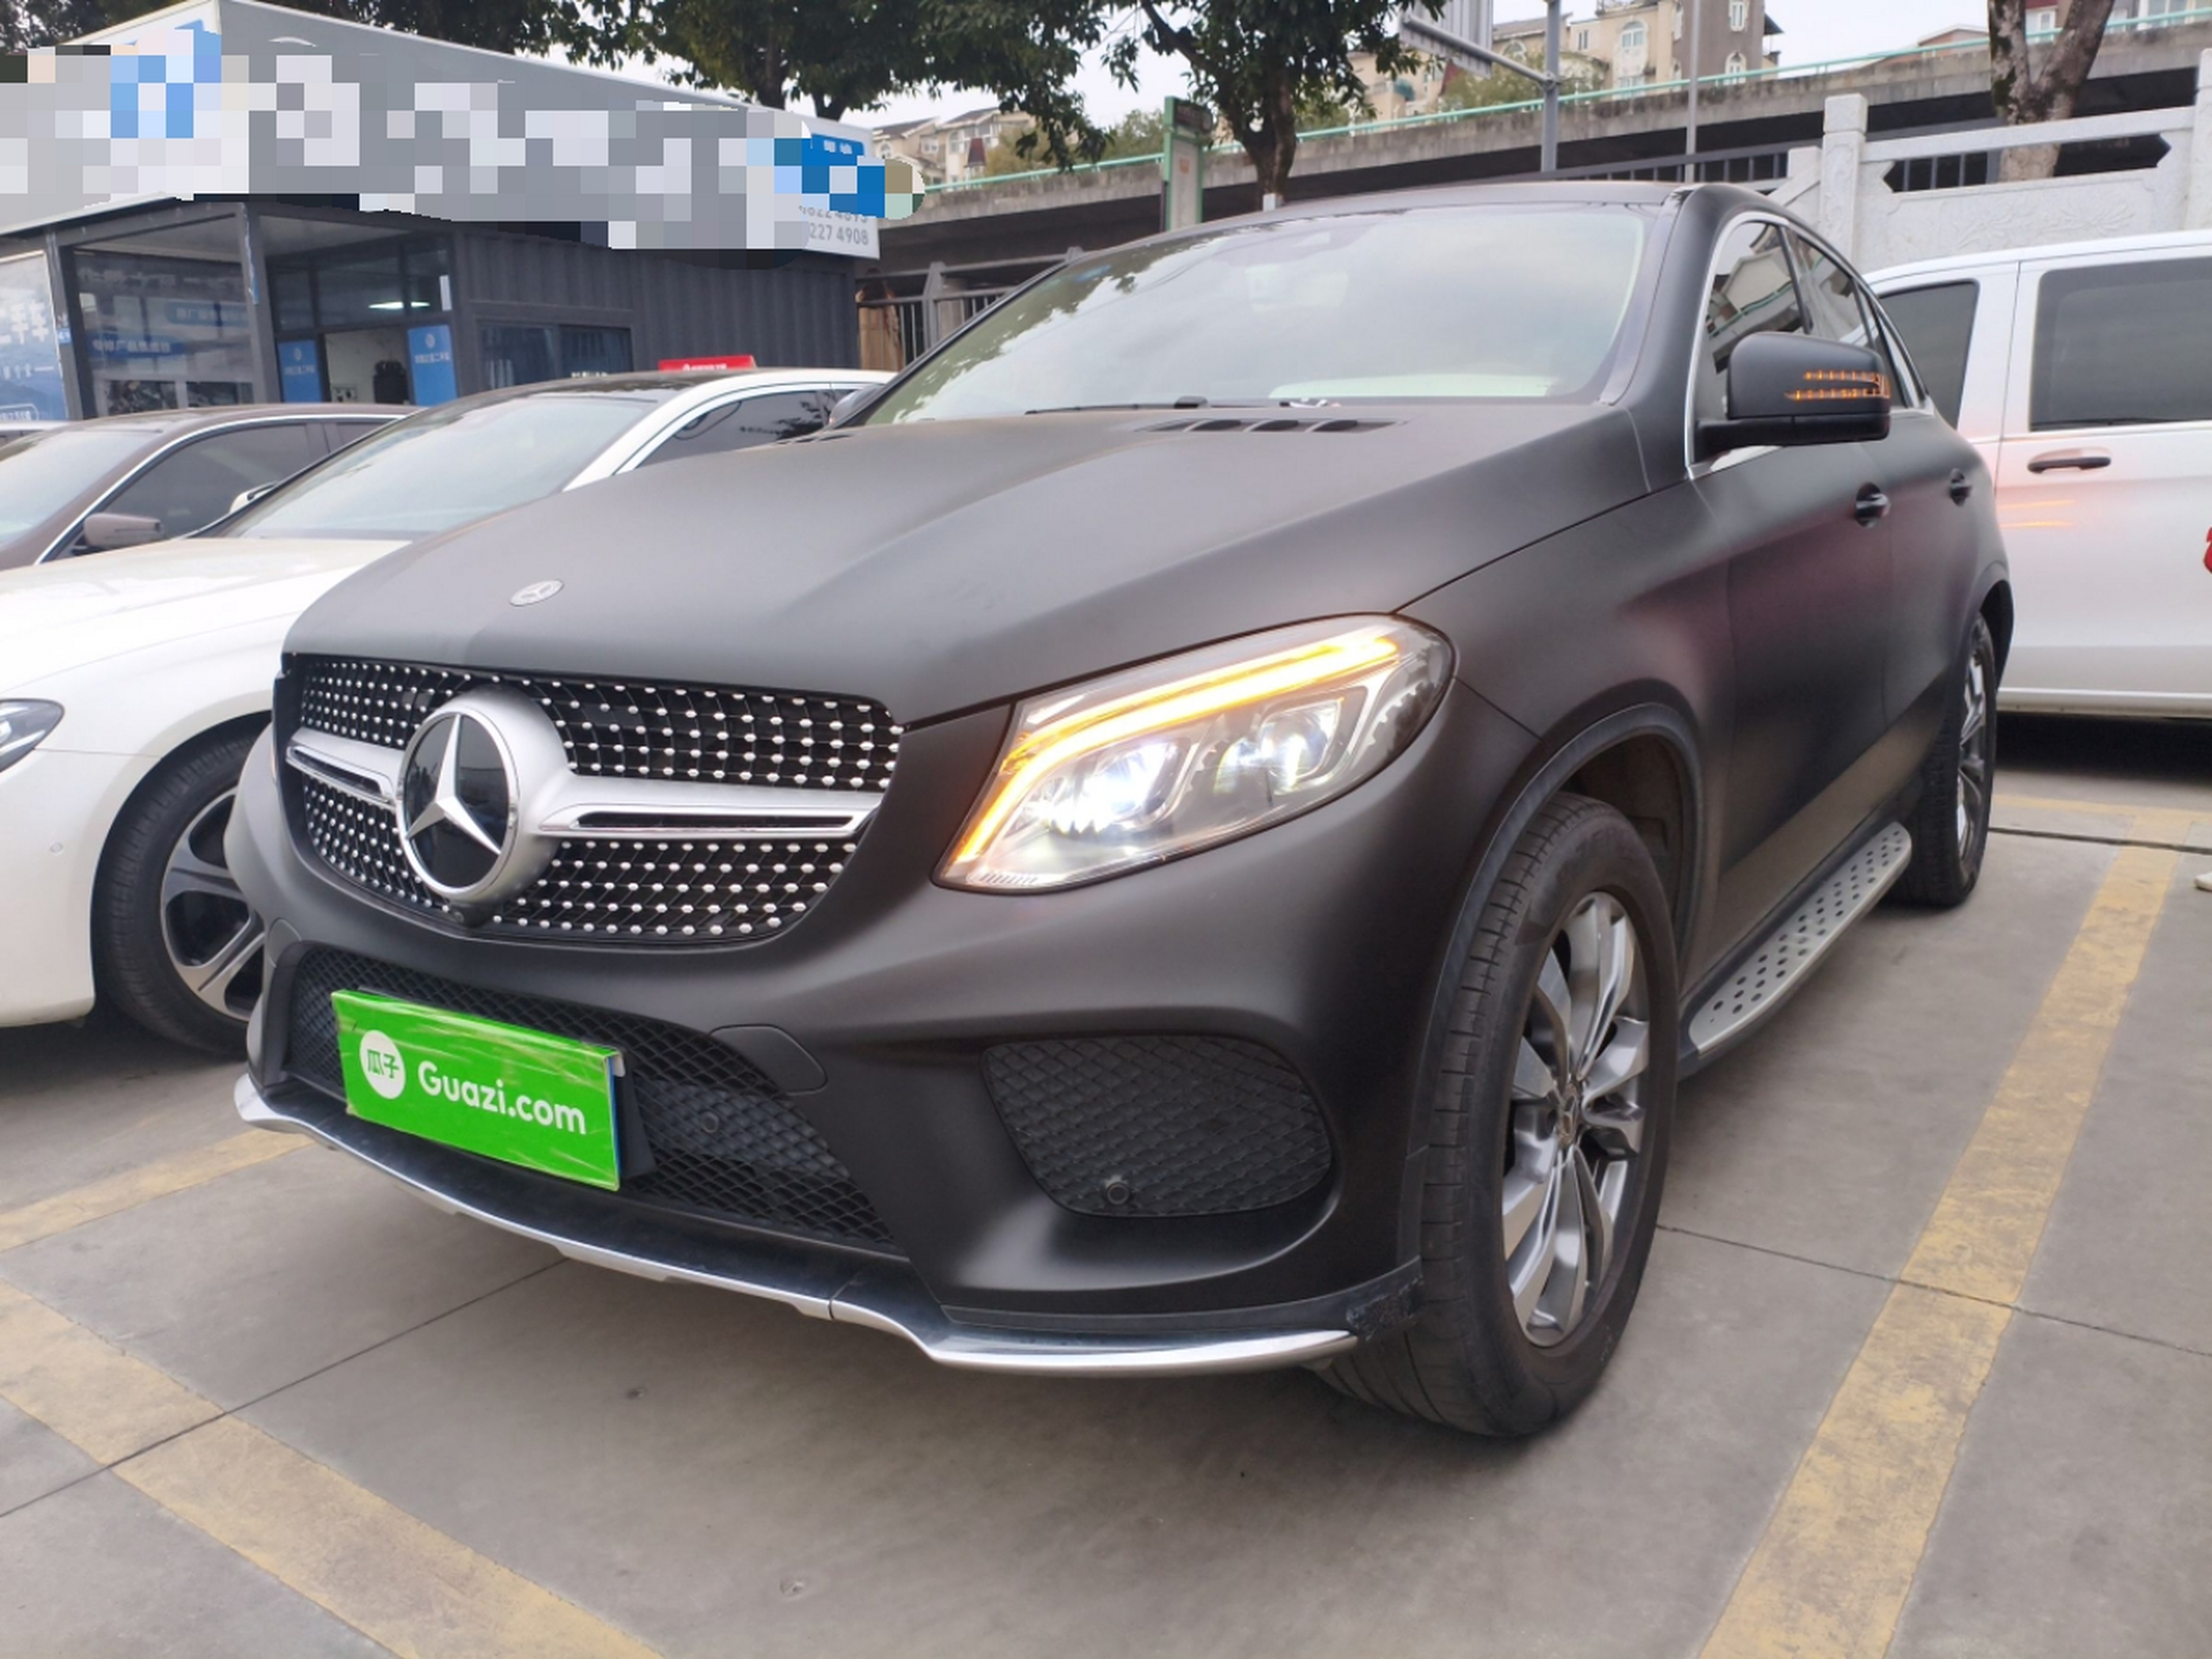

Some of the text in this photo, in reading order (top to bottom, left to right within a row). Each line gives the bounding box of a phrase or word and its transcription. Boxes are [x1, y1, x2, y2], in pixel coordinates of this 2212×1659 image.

[836, 226, 868, 245] 4908
[367, 1049, 399, 1079] 瓜子
[418, 1060, 586, 1135] Guazi.com
